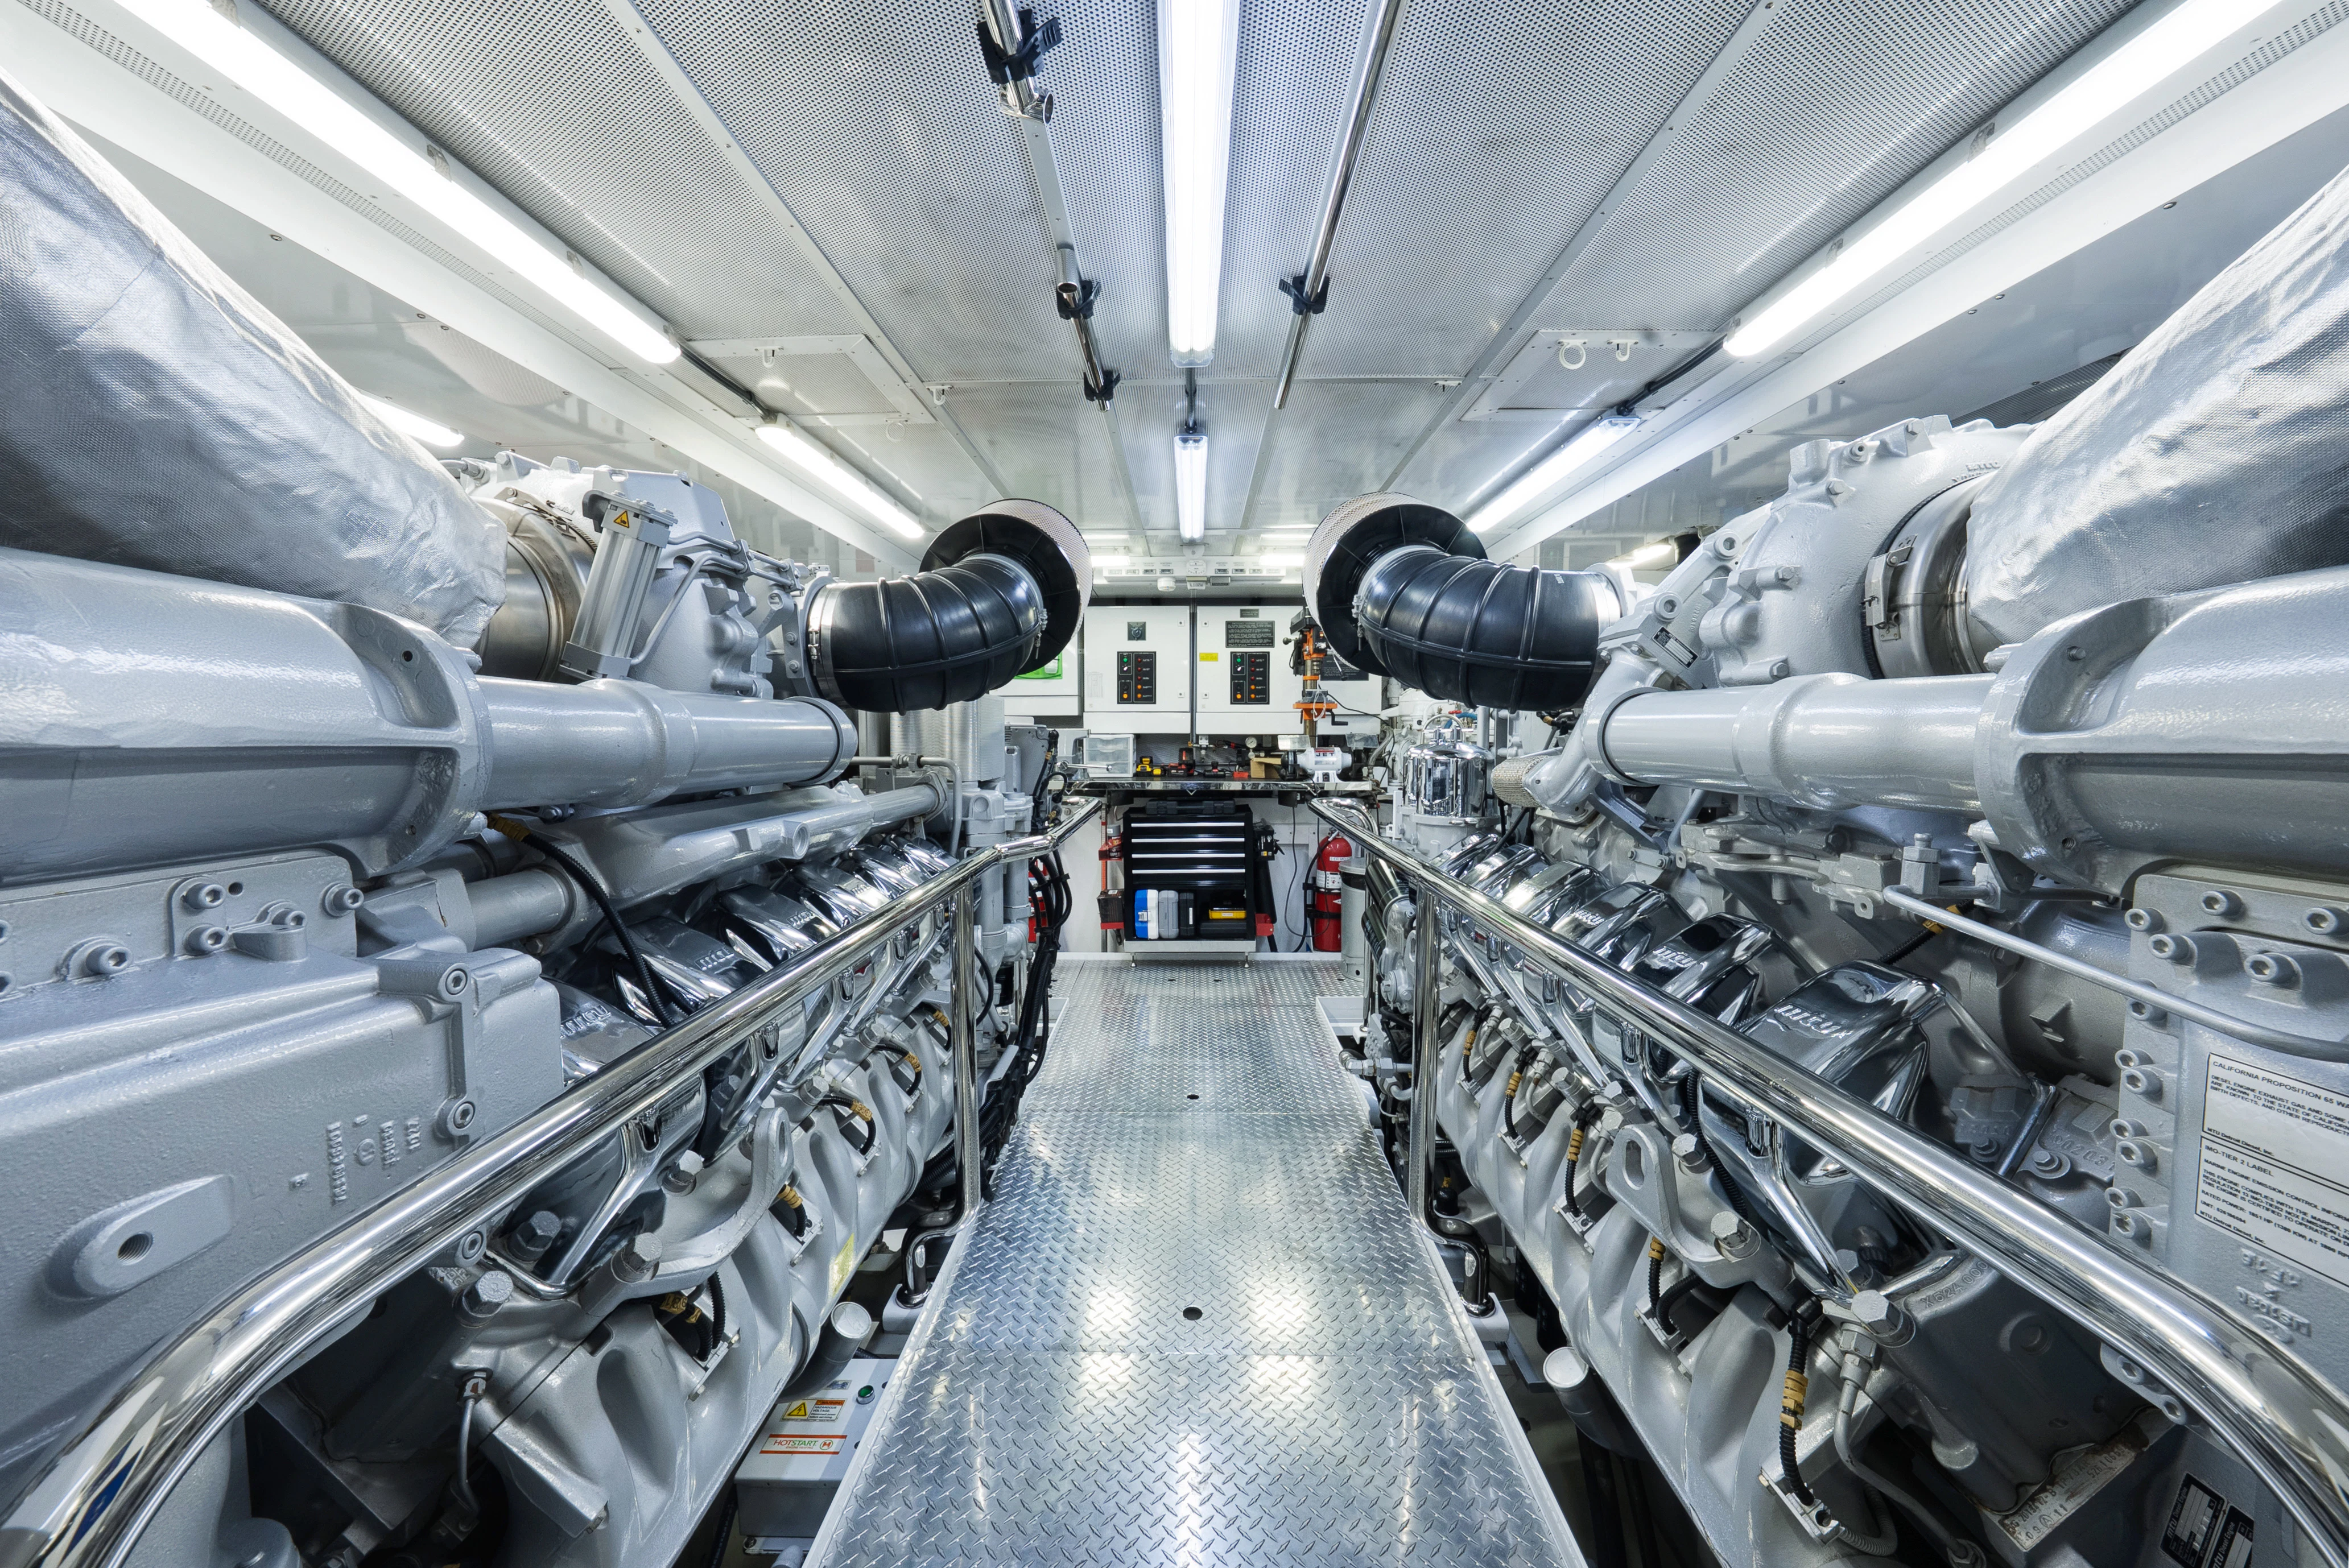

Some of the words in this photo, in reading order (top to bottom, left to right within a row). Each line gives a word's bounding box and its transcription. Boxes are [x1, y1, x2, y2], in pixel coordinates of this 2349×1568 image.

[700, 948, 734, 971] mtu
[1653, 947, 1697, 968] mtu
[1774, 1004, 1842, 1034] mtu
[2212, 1061, 2259, 1080] CALIFORNIA
[2261, 1076, 2321, 1100] PROPOSITION
[2210, 1085, 2228, 1095] BIRTH
[2276, 1108, 2300, 1119] OTHER
[2211, 1075, 2231, 1085] DIESEL
[2233, 1082, 2257, 1093] ENGINE
[2258, 1090, 2289, 1104] EXHAUST
[2290, 1101, 2306, 1110] GAS
[2307, 1107, 2322, 1115] AND
[2324, 1112, 2346, 1123] SOME
[2226, 1085, 2249, 1096] KNOWN
[2277, 1103, 2300, 1113] STATE
[2220, 1132, 2240, 1143] Detroit
[2204, 1145, 2238, 1162] IMO-TIER
[2247, 1161, 2274, 1176] LABEL
[2203, 1159, 2226, 1170] MARINE
[2227, 1168, 2250, 1181] ENGINE
[2252, 1178, 2284, 1195] EMISSION
[2285, 1192, 2319, 1210] CONTROL
[2203, 1169, 2215, 1177] THIS
[2216, 1174, 2239, 1187] ENGINE
[2241, 1185, 2274, 1202] COMPLIES
[2276, 1199, 2294, 1211] WITH
[2294, 1207, 2309, 1217] THE
[2310, 1214, 2341, 1231] MARPOL
[2199, 1210, 2212, 1219] MTU
[2212, 1217, 2231, 1228] Detroit
[2201, 1189, 2220, 1201] RATED
[2222, 1198, 2246, 1213] POWER:
[2307, 1236, 2318, 1245] AT
[2202, 1174, 2240, 1193] REGULATION
[2301, 1216, 2336, 1235] EMISSION
[2202, 1179, 2215, 1188] THIS
[2216, 1185, 2239, 1198] ENGINE
[2247, 1199, 2282, 1217] CERTIFIED
[2294, 1219, 2328, 1238] OPERATE
[2330, 1234, 2342, 1243] ON
[2166, 1519, 2178, 1538] mtu
[2173, 1502, 2181, 1517] Diesel
[2178, 1486, 2189, 1504] Engine
[2219, 1539, 2228, 1554] Diesel
[2224, 1521, 2236, 1540] Engine
